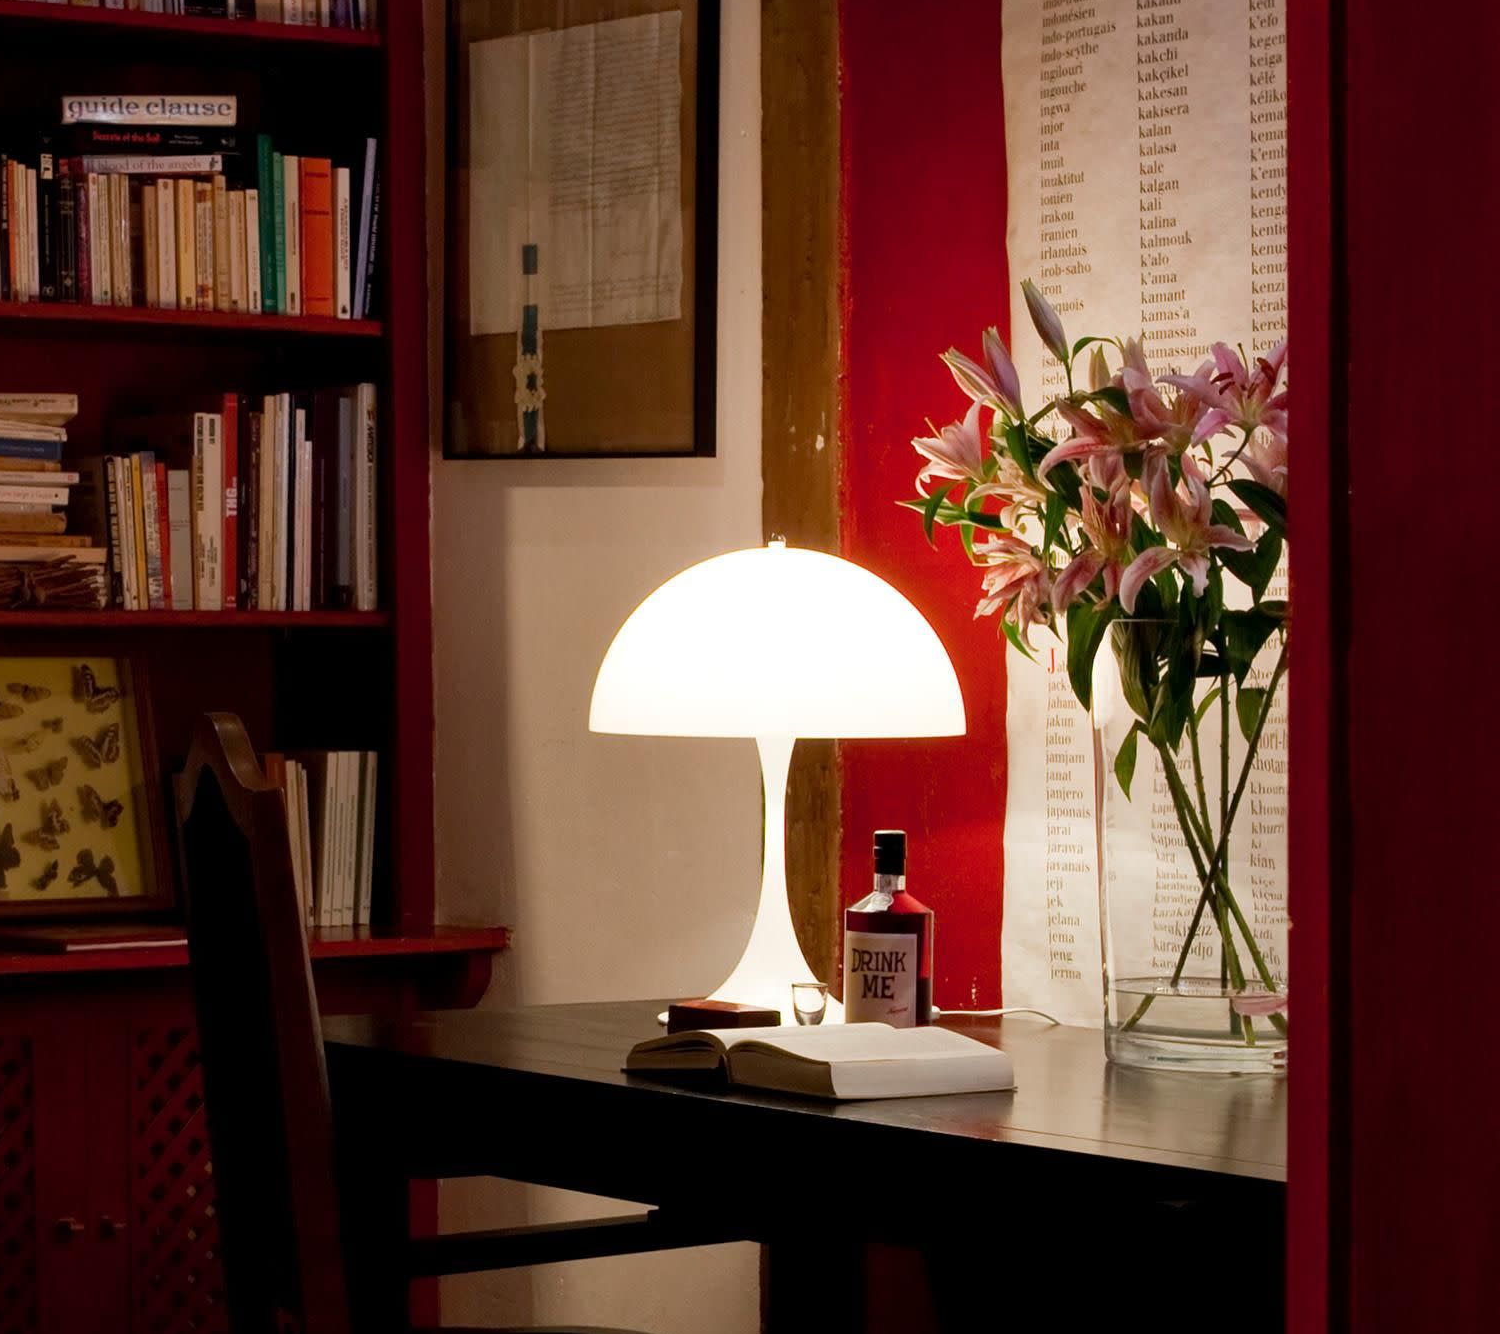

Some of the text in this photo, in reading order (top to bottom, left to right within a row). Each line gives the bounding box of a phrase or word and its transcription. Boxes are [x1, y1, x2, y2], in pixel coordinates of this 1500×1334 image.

[1042, 7, 1096, 27] indonésien
[1136, 13, 1174, 29] kakan
[1041, 21, 1117, 45] indo-portugais
[1136, 28, 1189, 47] kakanda
[1040, 42, 1099, 64] indo-scythe
[1136, 47, 1178, 65] kakchi
[1137, 64, 1189, 84] kakçikel
[1040, 80, 1087, 100] ingouche
[1138, 86, 1188, 102] kakesan
[67, 97, 232, 119] guide clause
[1040, 103, 1071, 119] ingwa
[1138, 104, 1189, 120] kakisera
[1040, 121, 1065, 136] injor
[1138, 123, 1172, 139] kalan
[1040, 140, 1060, 153] inta
[1139, 142, 1177, 157] kalasa
[97, 157, 201, 172] blood of the angels
[1139, 160, 1164, 176] kale
[1040, 171, 1084, 189] inuktitut
[1139, 179, 1179, 195] kalgan
[1139, 197, 1162, 212] kali
[1040, 209, 1074, 225] irakou
[1140, 216, 1177, 230] kalina
[1040, 226, 1078, 243] iranien
[1140, 230, 1192, 249] kalmouk
[1040, 243, 1087, 260] irlandais
[1040, 261, 1092, 279] irob-saho
[1141, 289, 1185, 304] kamant
[1046, 805, 1091, 820] japonais
[852, 948, 907, 973] DRINK
[861, 974, 895, 1001] ME
